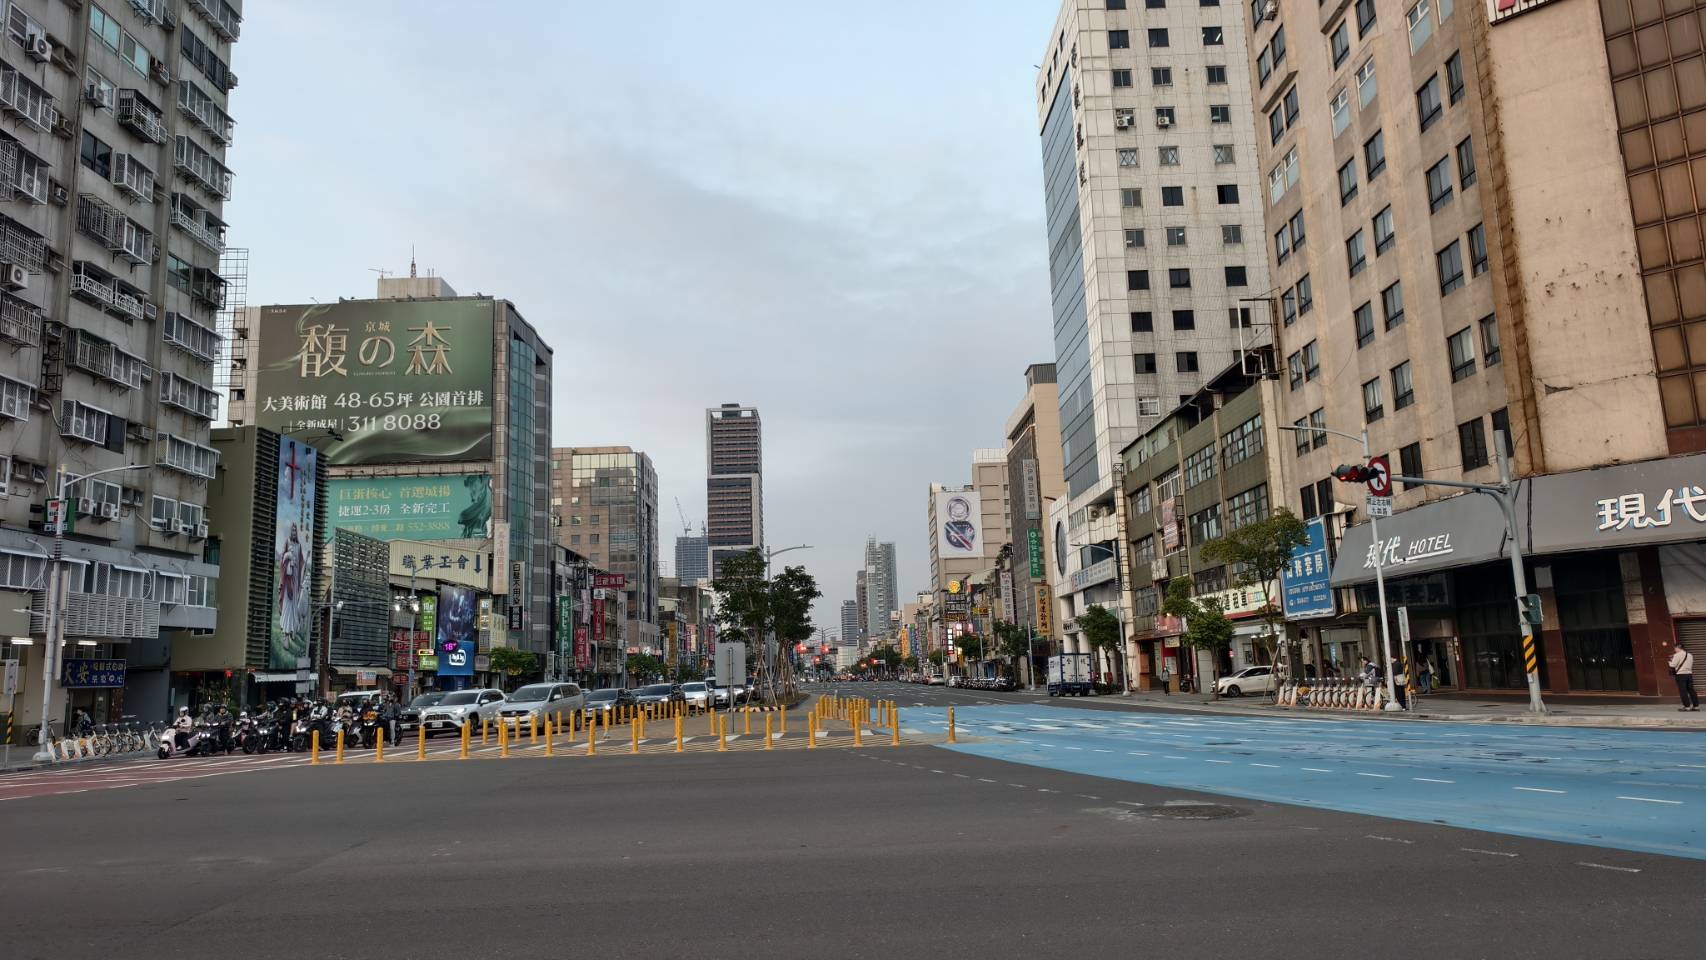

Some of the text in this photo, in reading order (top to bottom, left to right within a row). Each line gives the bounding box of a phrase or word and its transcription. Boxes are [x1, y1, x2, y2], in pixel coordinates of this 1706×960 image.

[365, 321, 391, 333] 京城
[299, 320, 453, 378] 馥の森
[262, 390, 484, 412] 大美術館 48-65坪 公園首排
[296, 413, 441, 432] 全新成屋 311 8088
[340, 487, 392, 500] 巨蛋核心
[400, 502, 450, 515] 全新完工
[1597, 485, 1706, 531] 現代
[1408, 533, 1451, 556] HOTEL
[402, 553, 469, 570] 職業工會
